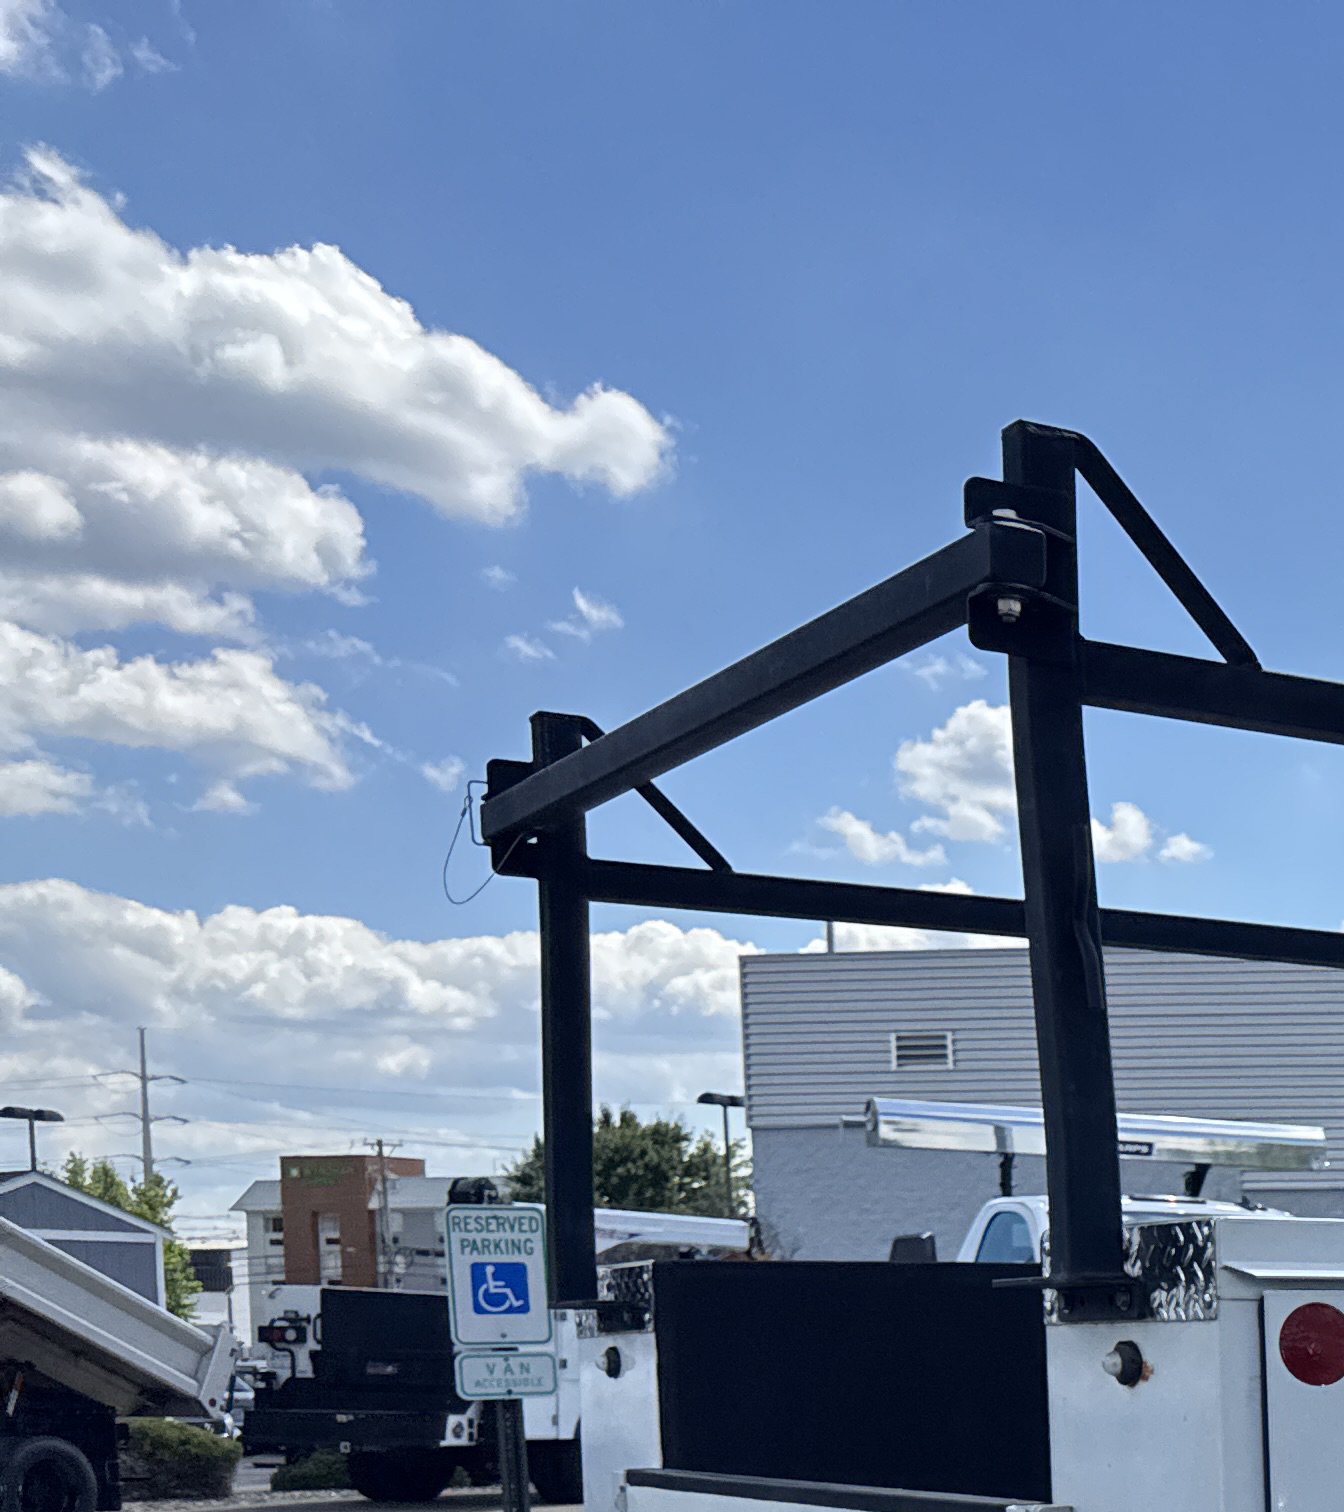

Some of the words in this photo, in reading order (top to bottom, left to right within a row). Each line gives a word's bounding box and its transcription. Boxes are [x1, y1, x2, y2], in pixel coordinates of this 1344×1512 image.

[451, 1215, 539, 1233] RESERVED
[460, 1238, 535, 1256] PARKING
[486, 1362, 532, 1376] VAN
[474, 1376, 545, 1389] ACCESSIBLE
